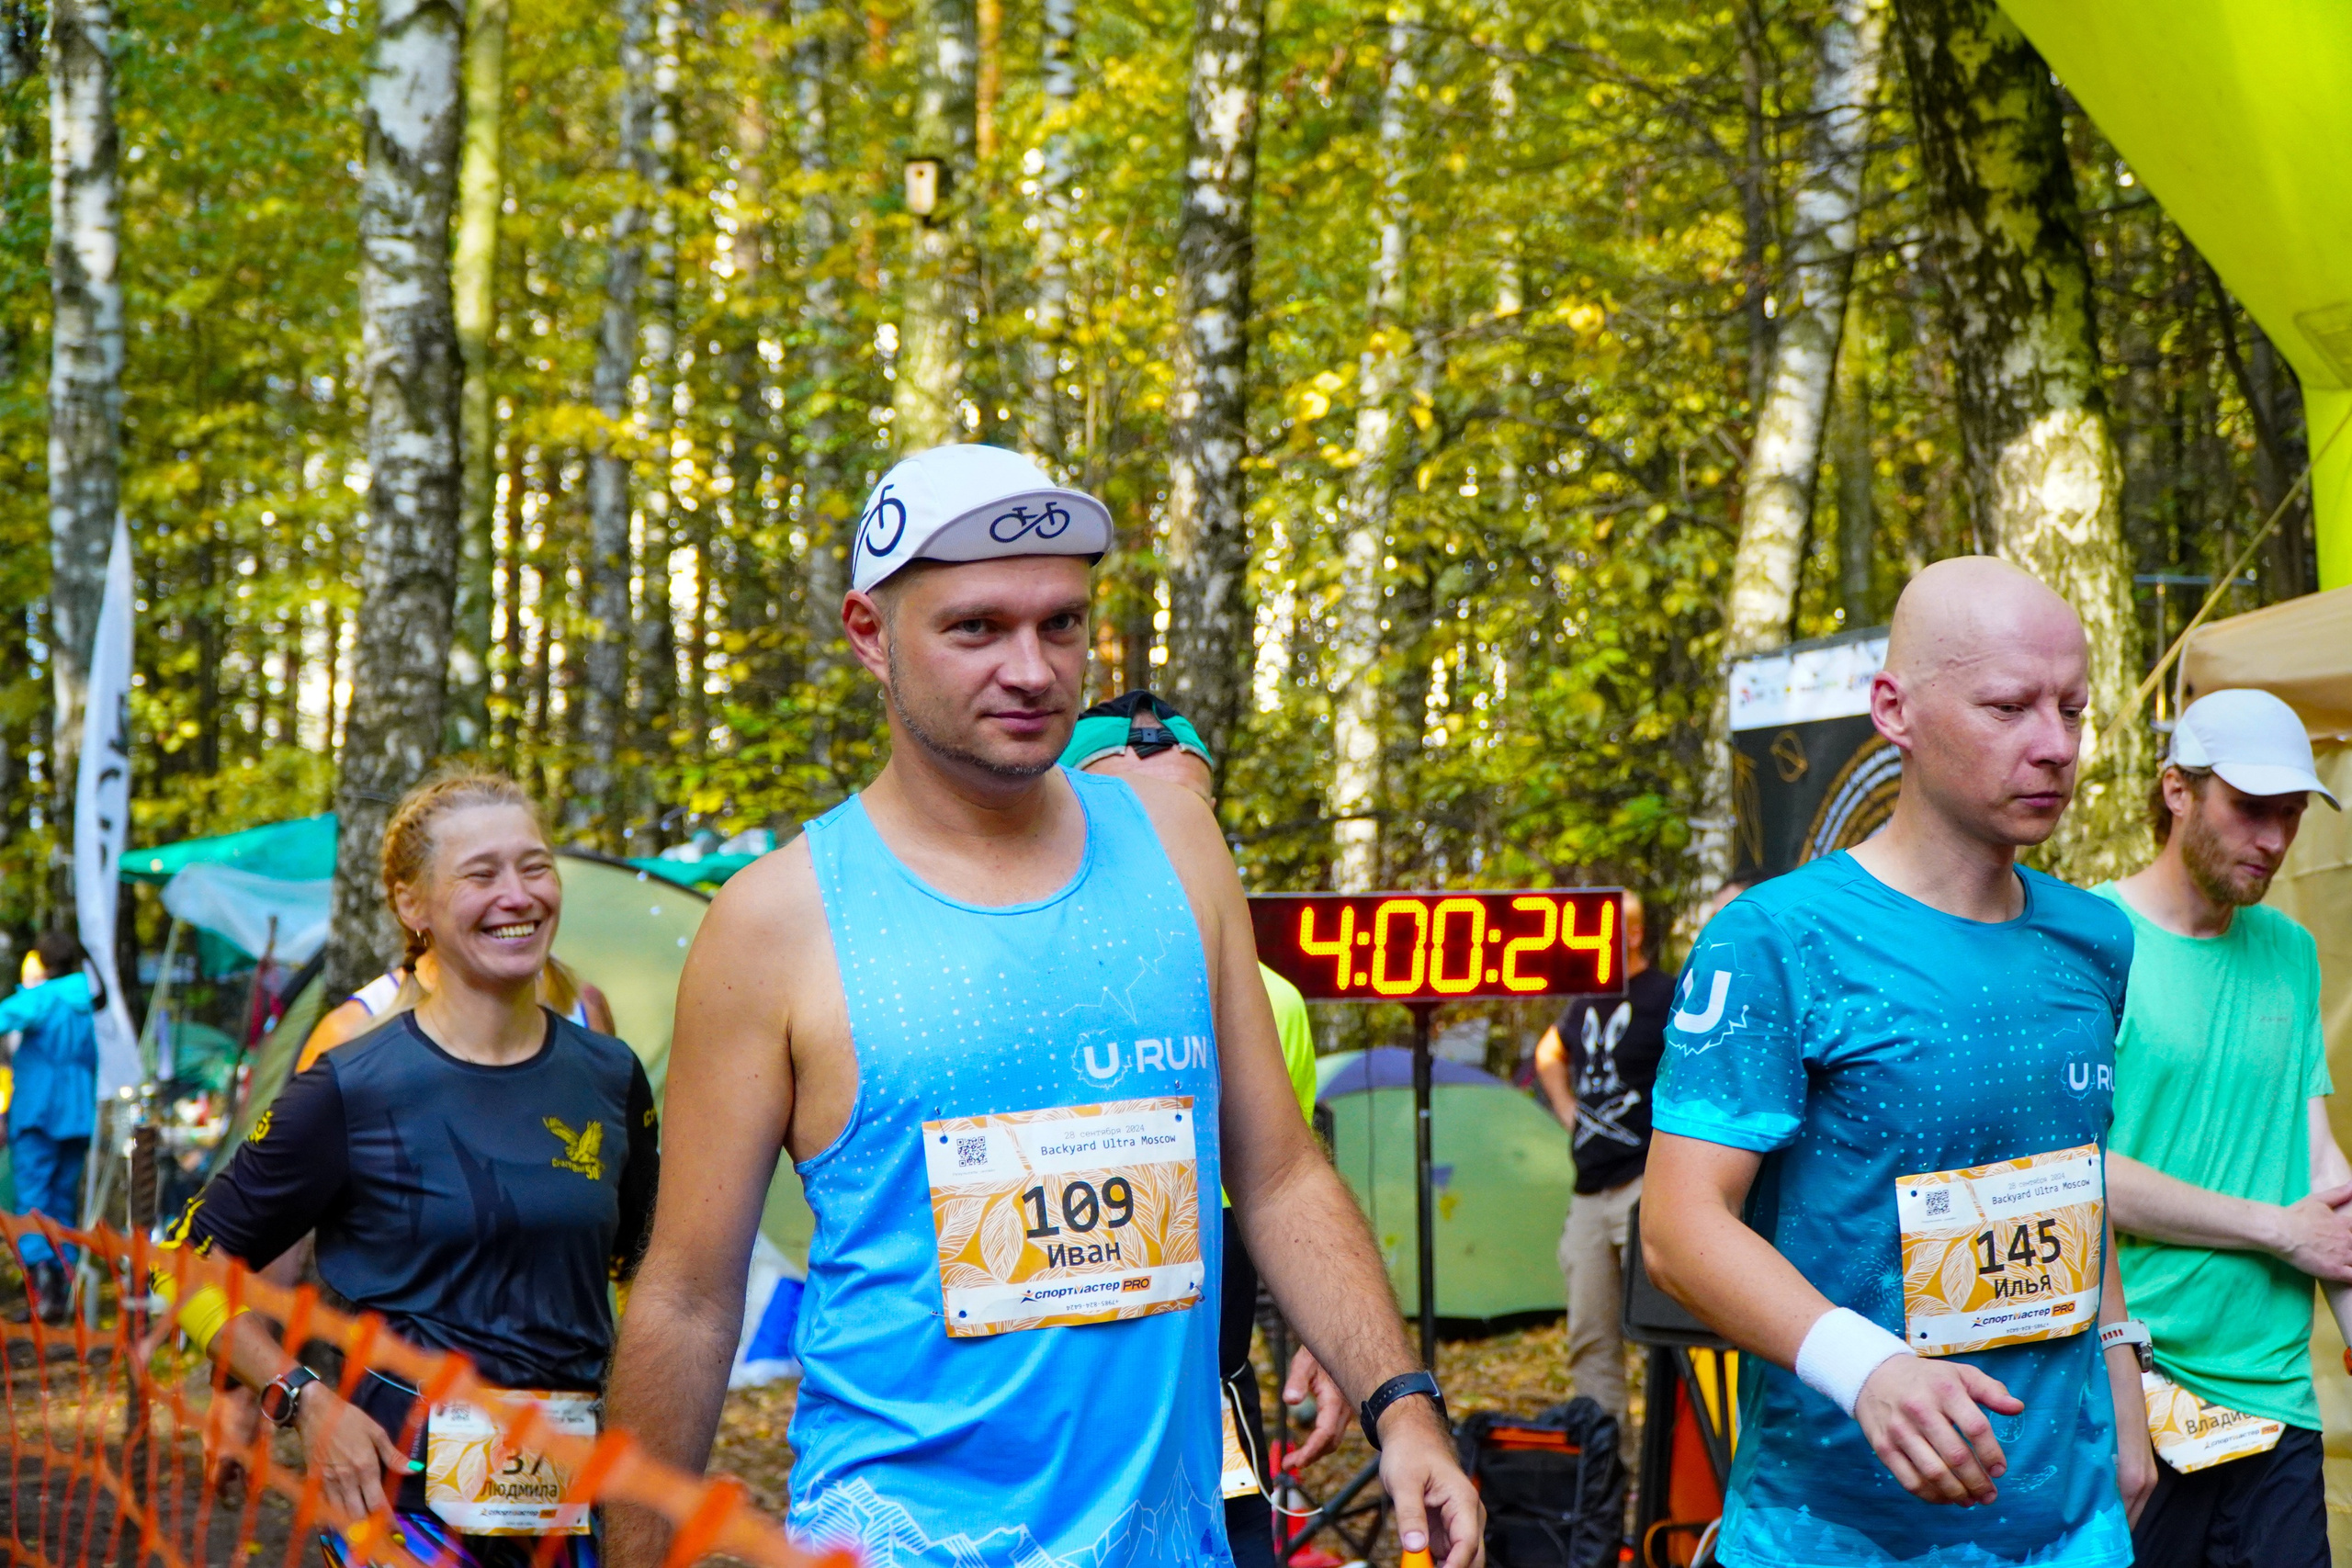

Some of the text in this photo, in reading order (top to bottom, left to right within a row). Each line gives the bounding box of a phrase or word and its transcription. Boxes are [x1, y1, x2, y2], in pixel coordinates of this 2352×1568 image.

[1299, 896, 1614, 995] 4:00:24
[1083, 1036, 1206, 1079] U RUN
[2069, 1062, 2089, 1091] U
[1040, 1134, 1176, 1156] Backyard Ultra Moscow
[1064, 1124, 1145, 1140] 28 сентября 2024
[1992, 1179, 2091, 1205] Backyard Ultra Moscow
[1022, 1176, 1134, 1239] 109
[1046, 1242, 1122, 1269] Иван
[1975, 1218, 2062, 1275] 145
[1123, 1278, 1150, 1292] PRO
[1994, 1274, 2052, 1299] Илья
[2052, 1302, 2076, 1315] PRO
[481, 1481, 558, 1499] Людмила
